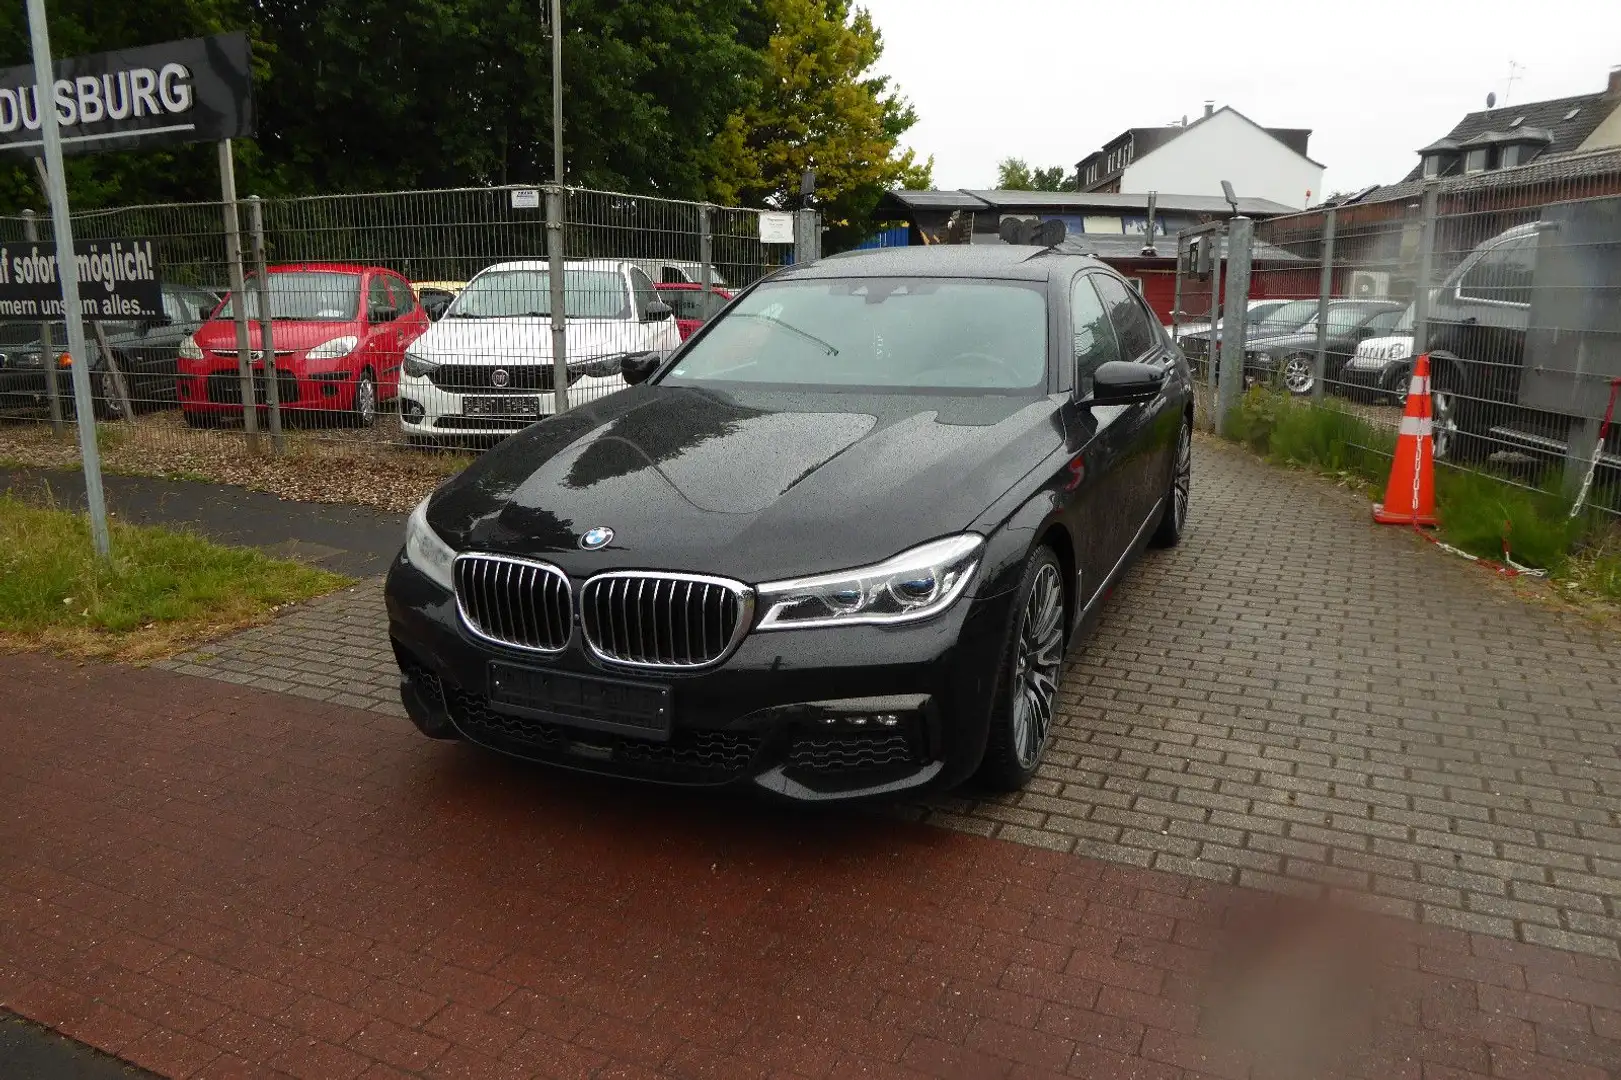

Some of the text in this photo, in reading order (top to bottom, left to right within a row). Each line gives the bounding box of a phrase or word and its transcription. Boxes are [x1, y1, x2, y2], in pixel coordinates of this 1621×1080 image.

[0, 63, 193, 132] DUSBURG
[13, 246, 58, 284] sofor
[75, 241, 154, 292] möglich!
